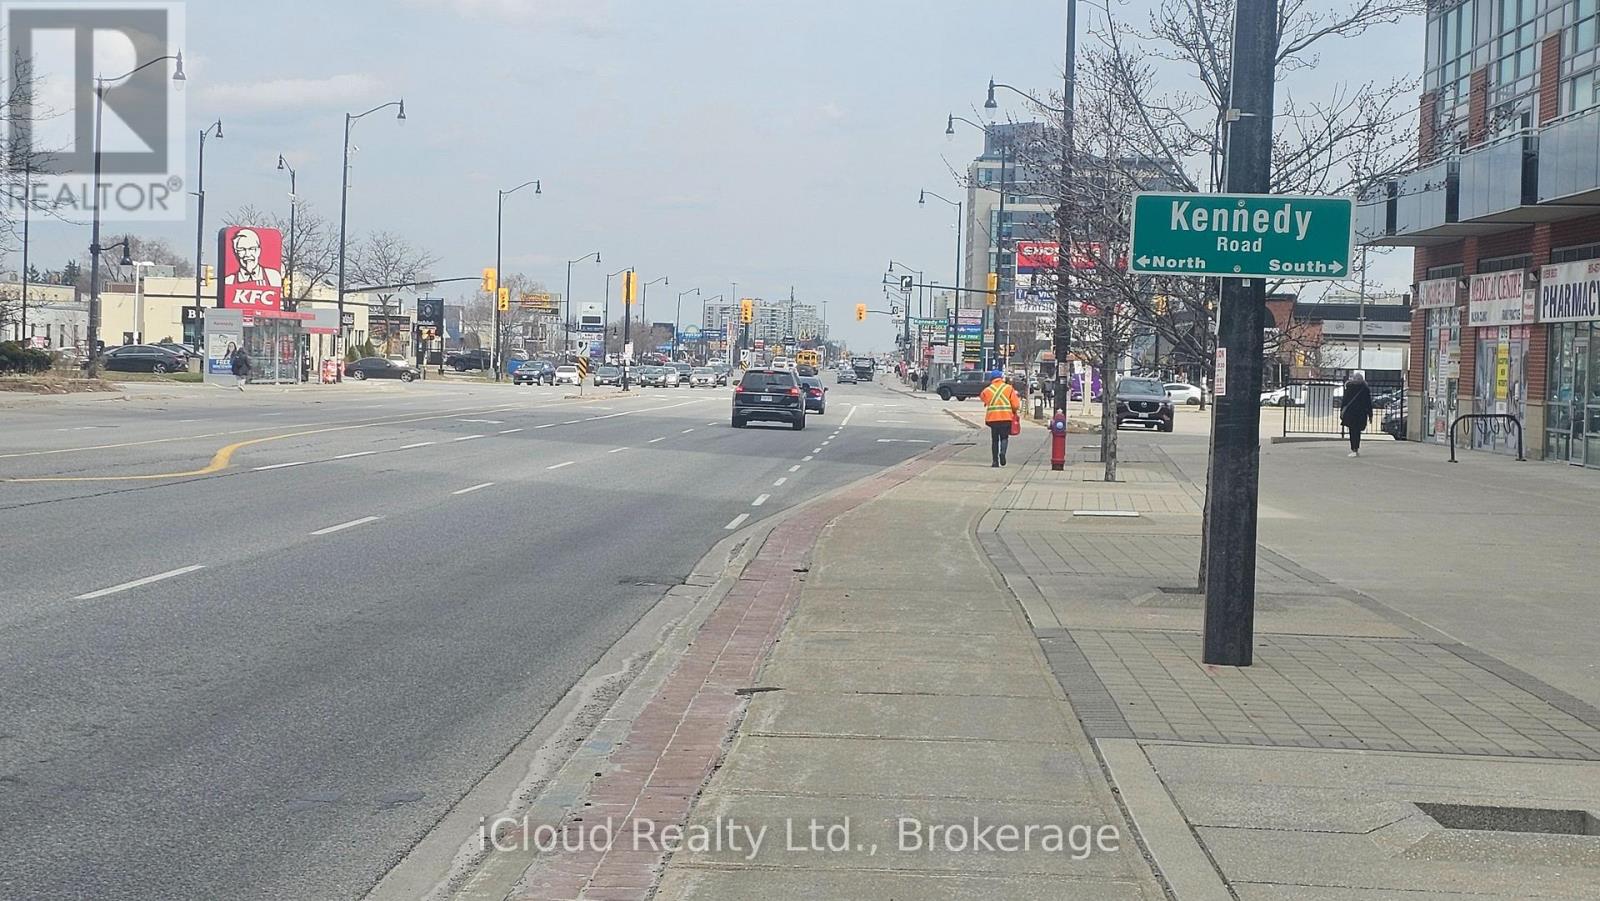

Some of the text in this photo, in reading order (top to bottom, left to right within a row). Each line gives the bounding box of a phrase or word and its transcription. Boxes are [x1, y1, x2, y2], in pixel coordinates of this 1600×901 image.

[1170, 200, 1312, 240] Kennedy
[1216, 236, 1263, 252] Road
[1152, 255, 1327, 273] North South
[1471, 276, 1497, 302] MEDICAL
[1498, 273, 1522, 299] CENTRE
[233, 289, 276, 306] KFC
